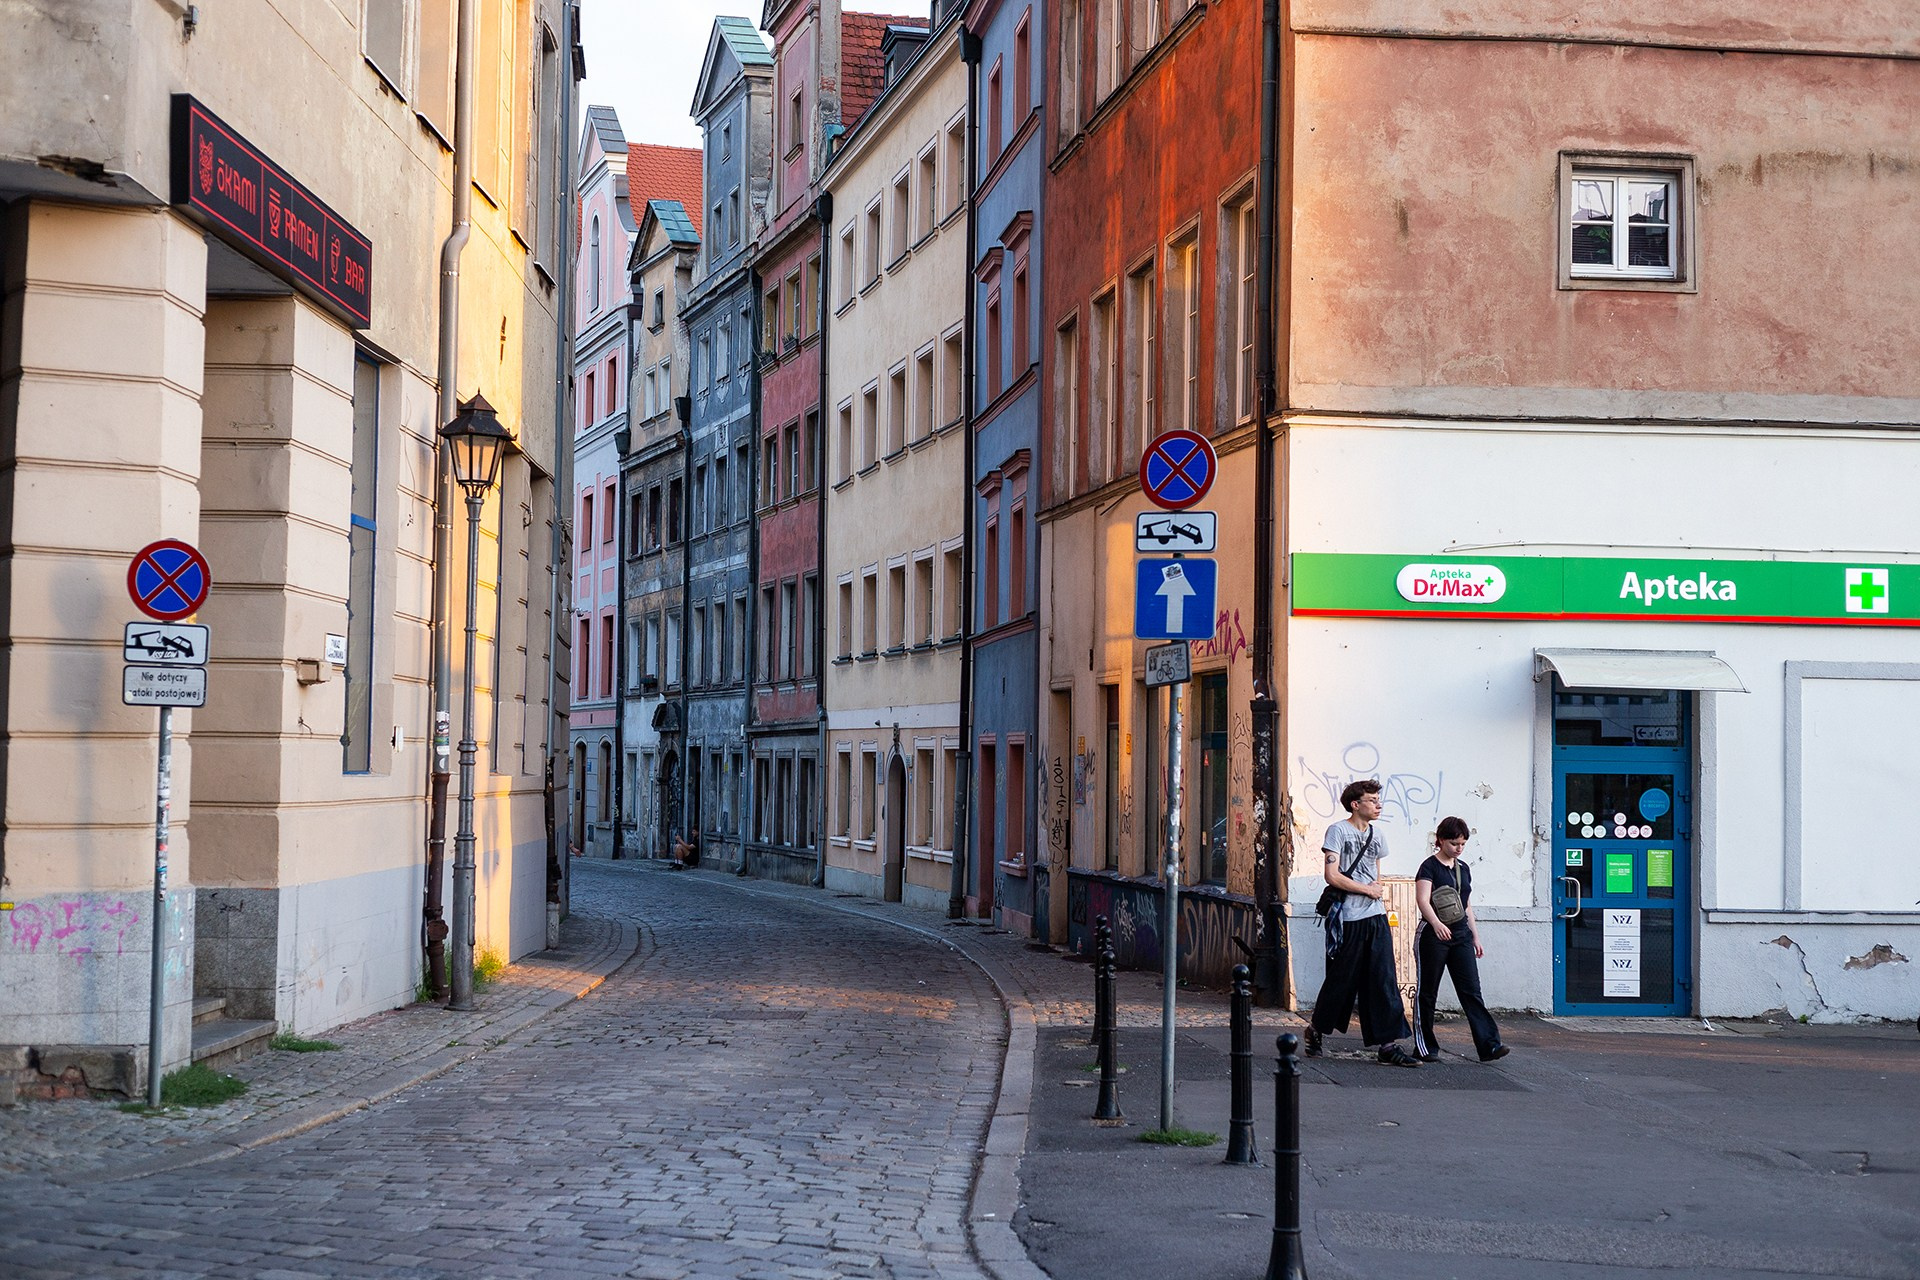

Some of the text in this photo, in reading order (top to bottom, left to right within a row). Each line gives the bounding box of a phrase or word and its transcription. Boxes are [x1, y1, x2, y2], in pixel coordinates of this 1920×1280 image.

[284, 208, 318, 262] RAMEN
[345, 256, 365, 295] BAR
[1430, 569, 1471, 580] Apteka
[1413, 579, 1485, 597] Dr.Max
[1619, 571, 1737, 606] Apteka
[141, 672, 188, 684] Nie dotyczy
[155, 688, 200, 700] postojowej
[1612, 914, 1633, 924] NFZ
[1612, 959, 1633, 968] NFZ
